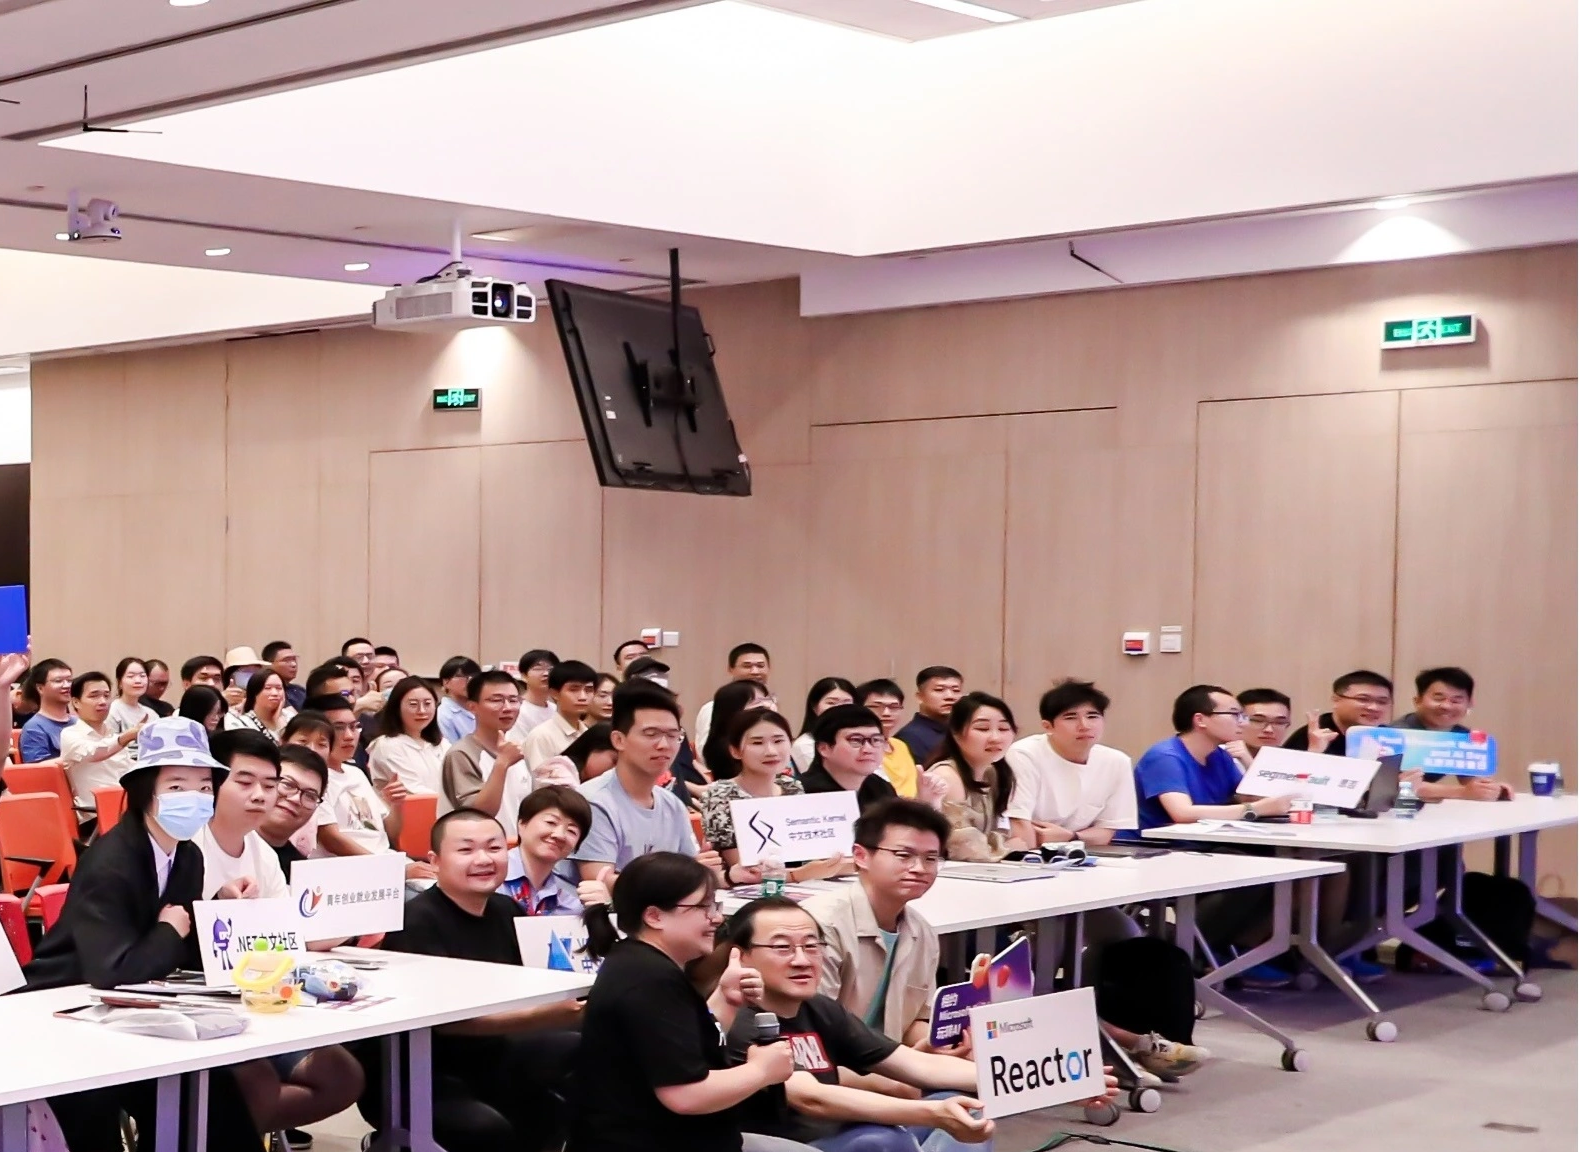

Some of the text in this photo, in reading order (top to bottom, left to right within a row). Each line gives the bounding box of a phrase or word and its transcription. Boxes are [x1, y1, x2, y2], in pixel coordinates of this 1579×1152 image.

[785, 815, 820, 827] Semantic
[789, 828, 836, 841] 中文技术社区
[327, 888, 400, 906] 青年创业就业发展平台
[999, 1017, 1034, 1034] Microsoft
[990, 1047, 1092, 1096] Reactor
